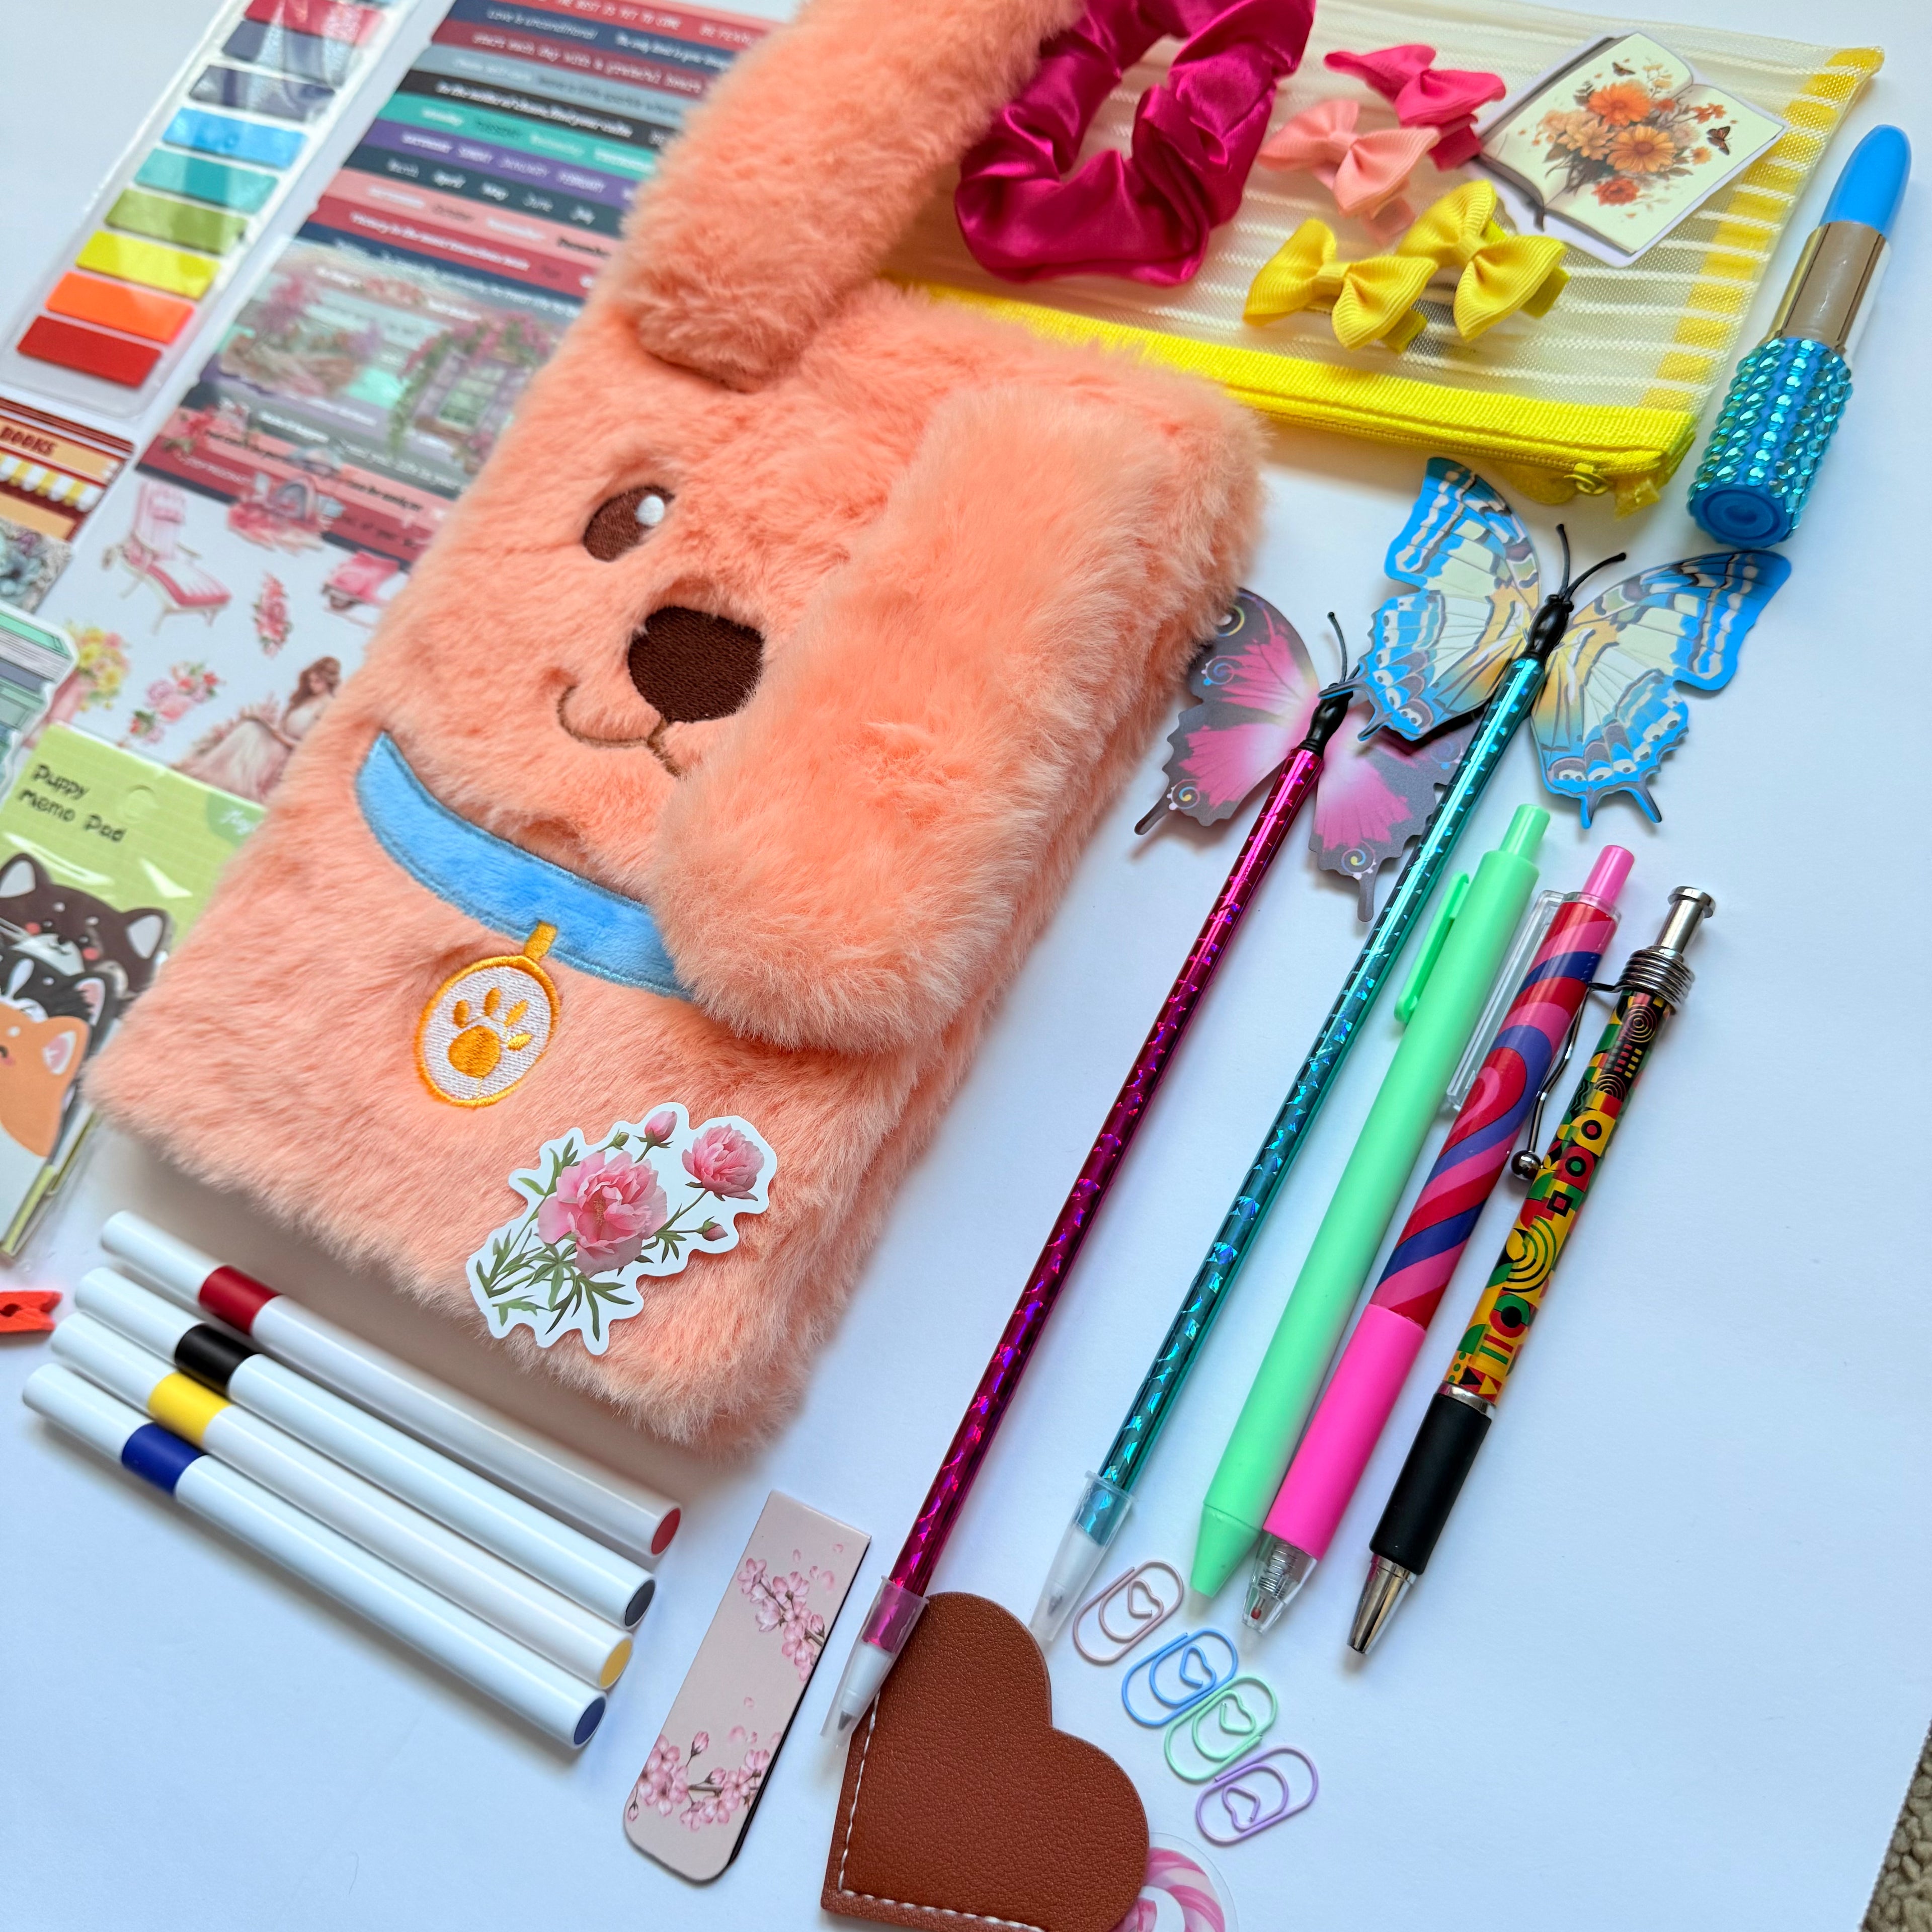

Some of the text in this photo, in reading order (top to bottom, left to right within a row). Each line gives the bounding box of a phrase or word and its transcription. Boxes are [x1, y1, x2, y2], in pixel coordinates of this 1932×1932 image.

[1, 427, 57, 456] BOOKS
[32, 763, 91, 800] Puppy
[83, 813, 128, 843] Pad
